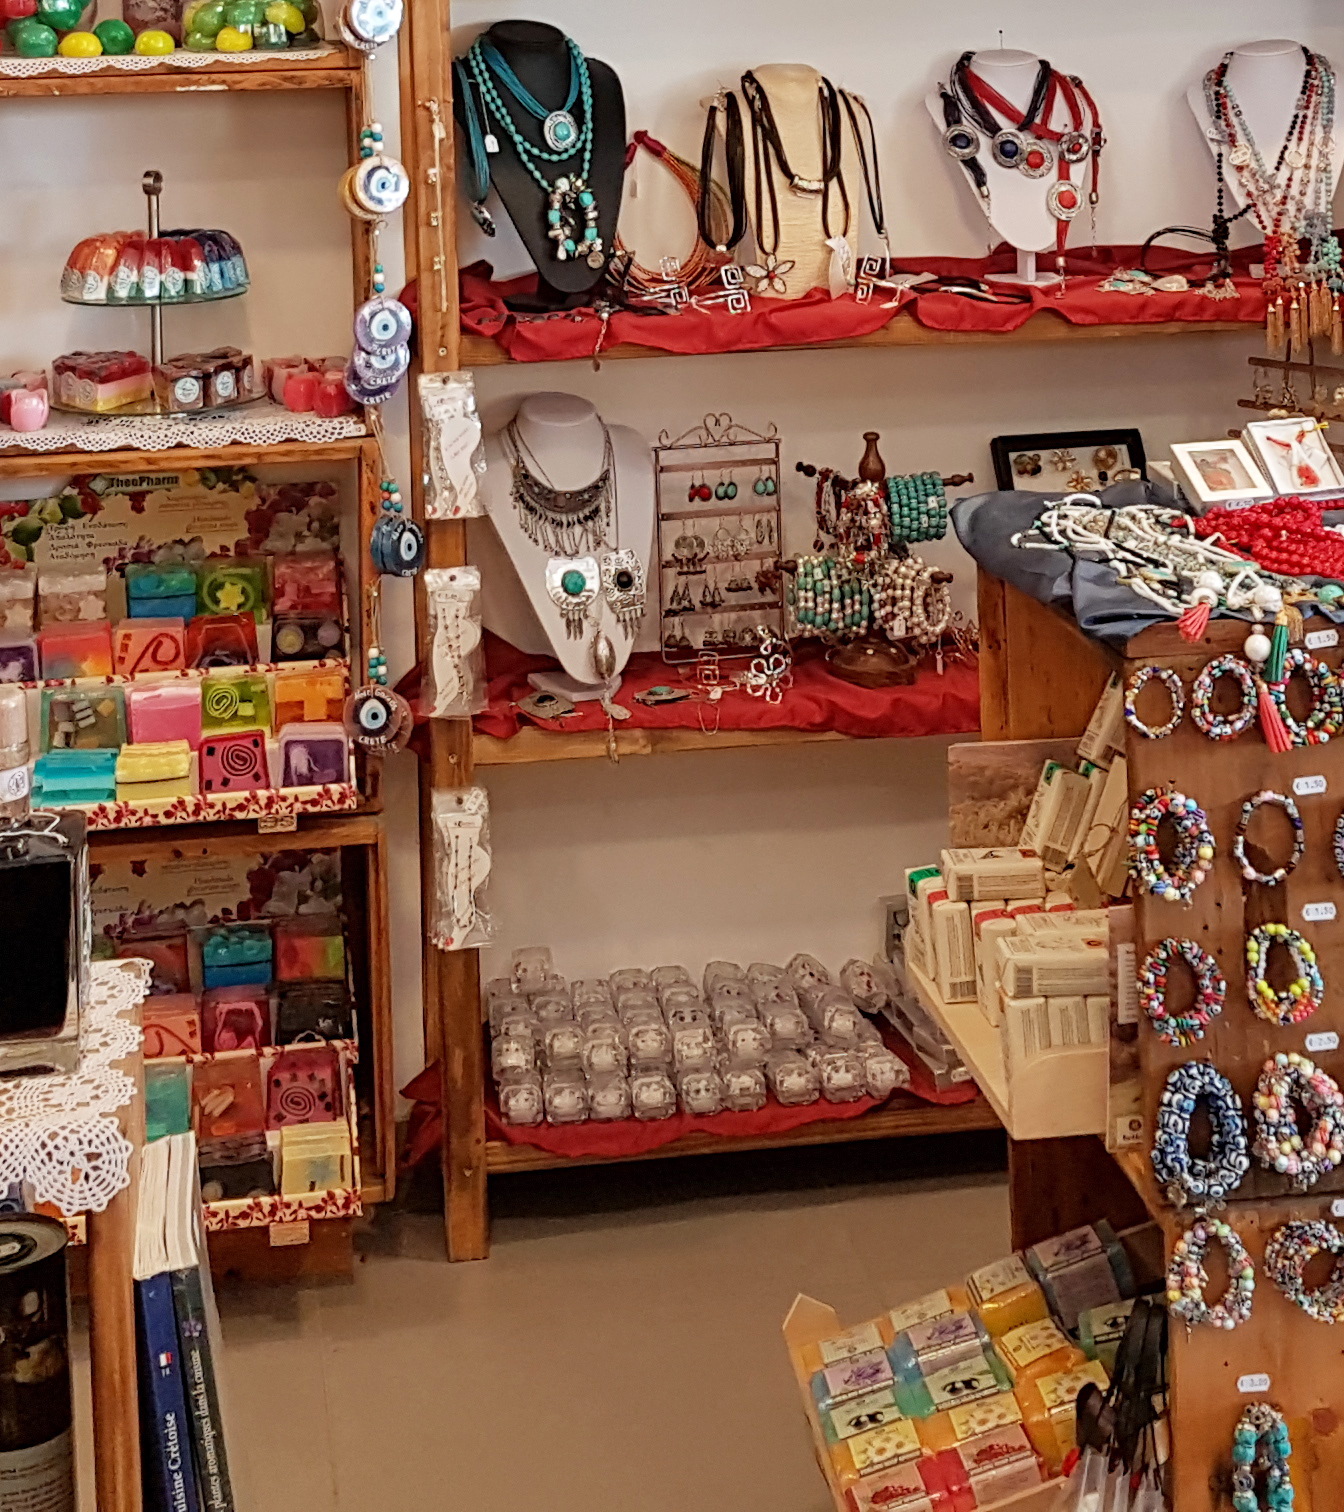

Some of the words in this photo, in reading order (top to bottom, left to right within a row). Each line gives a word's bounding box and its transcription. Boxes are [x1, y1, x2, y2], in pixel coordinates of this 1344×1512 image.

[110, 475, 179, 488] TheoPharm
[358, 736, 386, 745] CRETE
[200, 1418, 218, 1474] aromatiques
[169, 1471, 187, 1511] uisine
[208, 1476, 227, 1509] plantes
